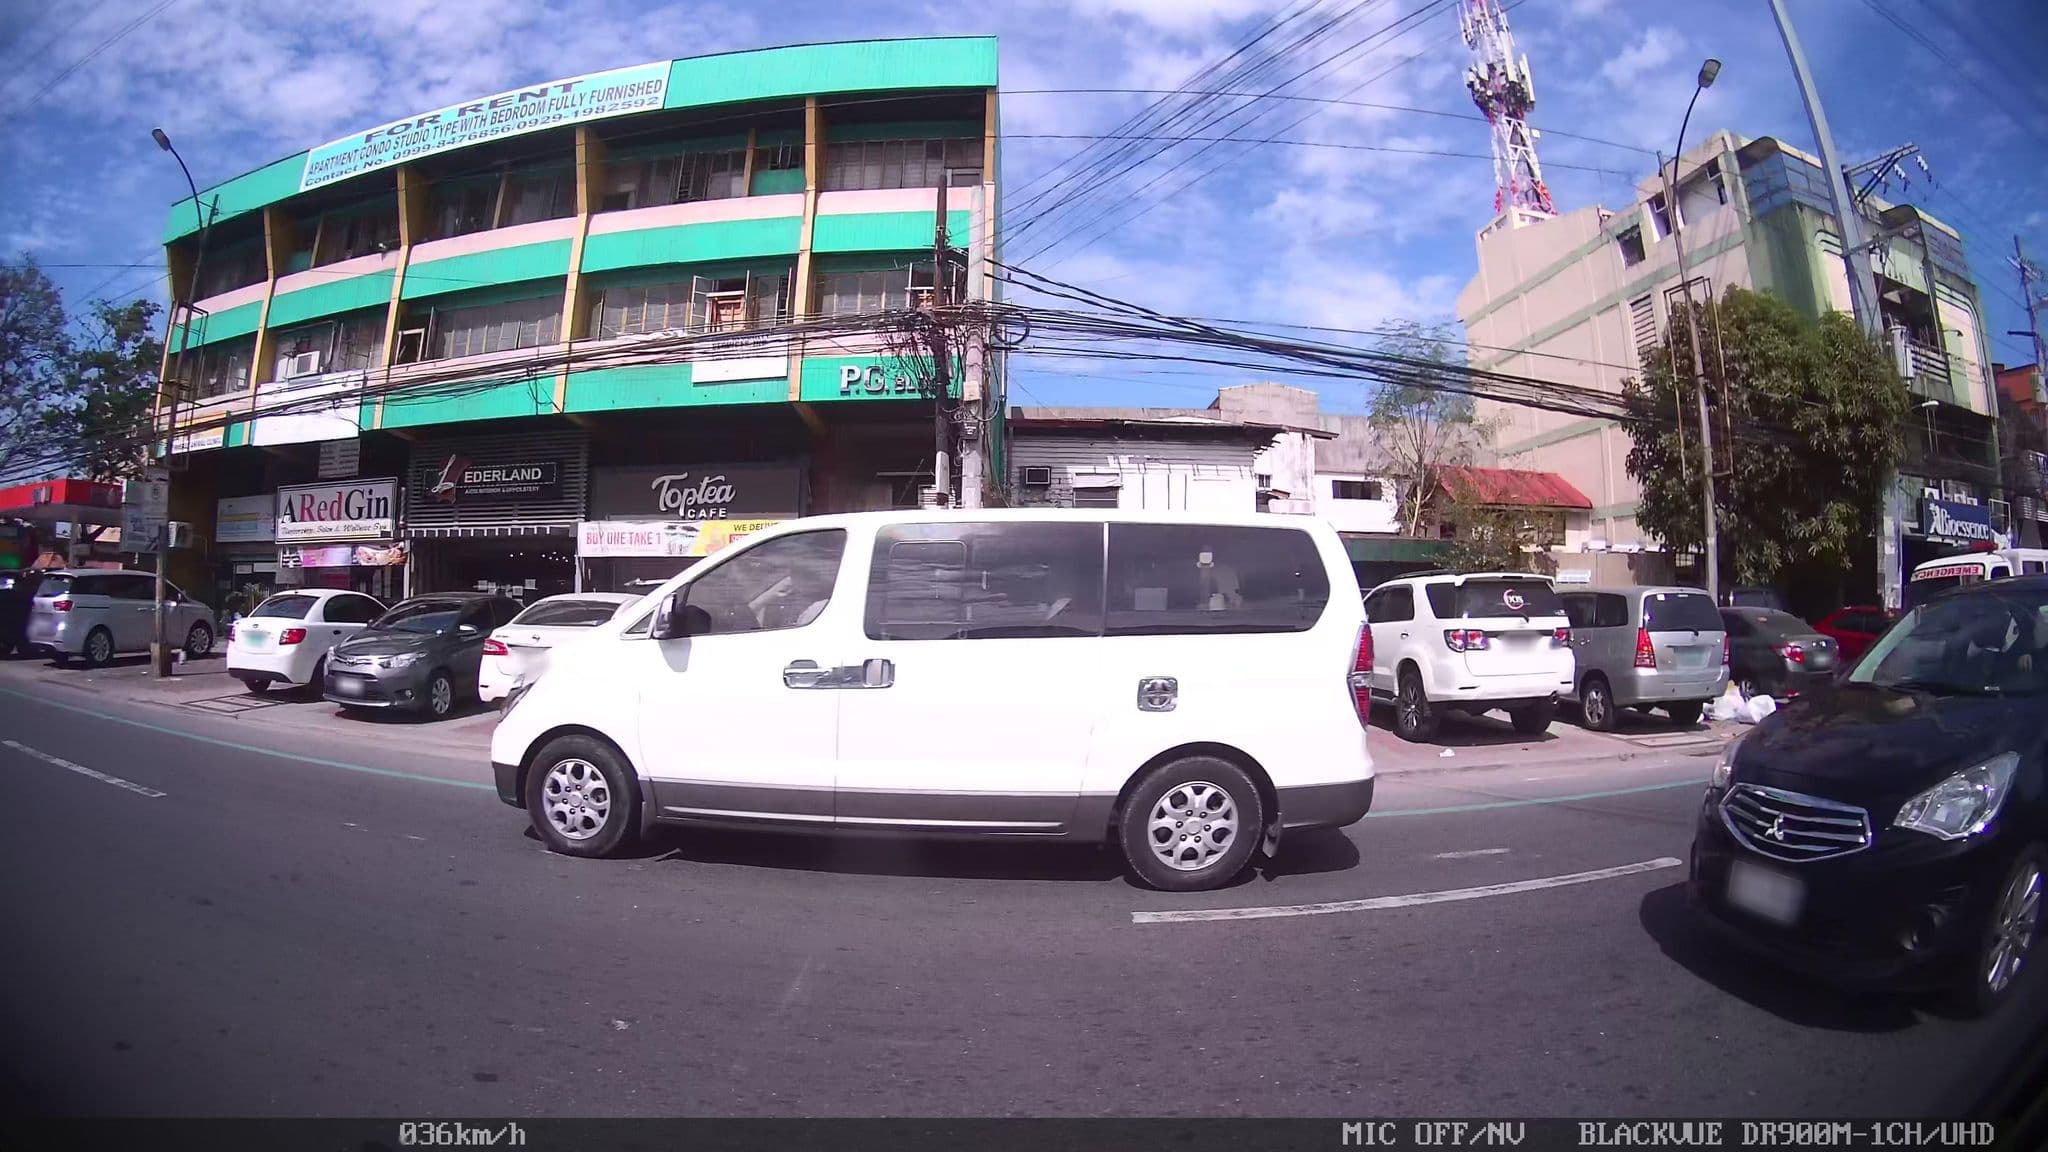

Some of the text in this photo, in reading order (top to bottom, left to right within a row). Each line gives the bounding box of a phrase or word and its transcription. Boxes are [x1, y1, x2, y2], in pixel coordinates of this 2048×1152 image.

[365, 80, 584, 144] FOR RENT
[393, 128, 429, 150] STUDIO
[432, 120, 458, 139] TYPE
[460, 114, 487, 132] WITH
[490, 101, 546, 125] BEDROOM
[550, 92, 587, 113] FULLY
[590, 79, 662, 102] FURNISHED
[305, 165, 358, 187] Contact
[363, 158, 386, 169] No.
[651, 471, 737, 517] Toptea
[687, 507, 728, 519] CAFE
[586, 531, 604, 545] BUY
[607, 531, 625, 545] ONE
[629, 531, 653, 545] TAKE
[734, 524, 747, 532] WE
